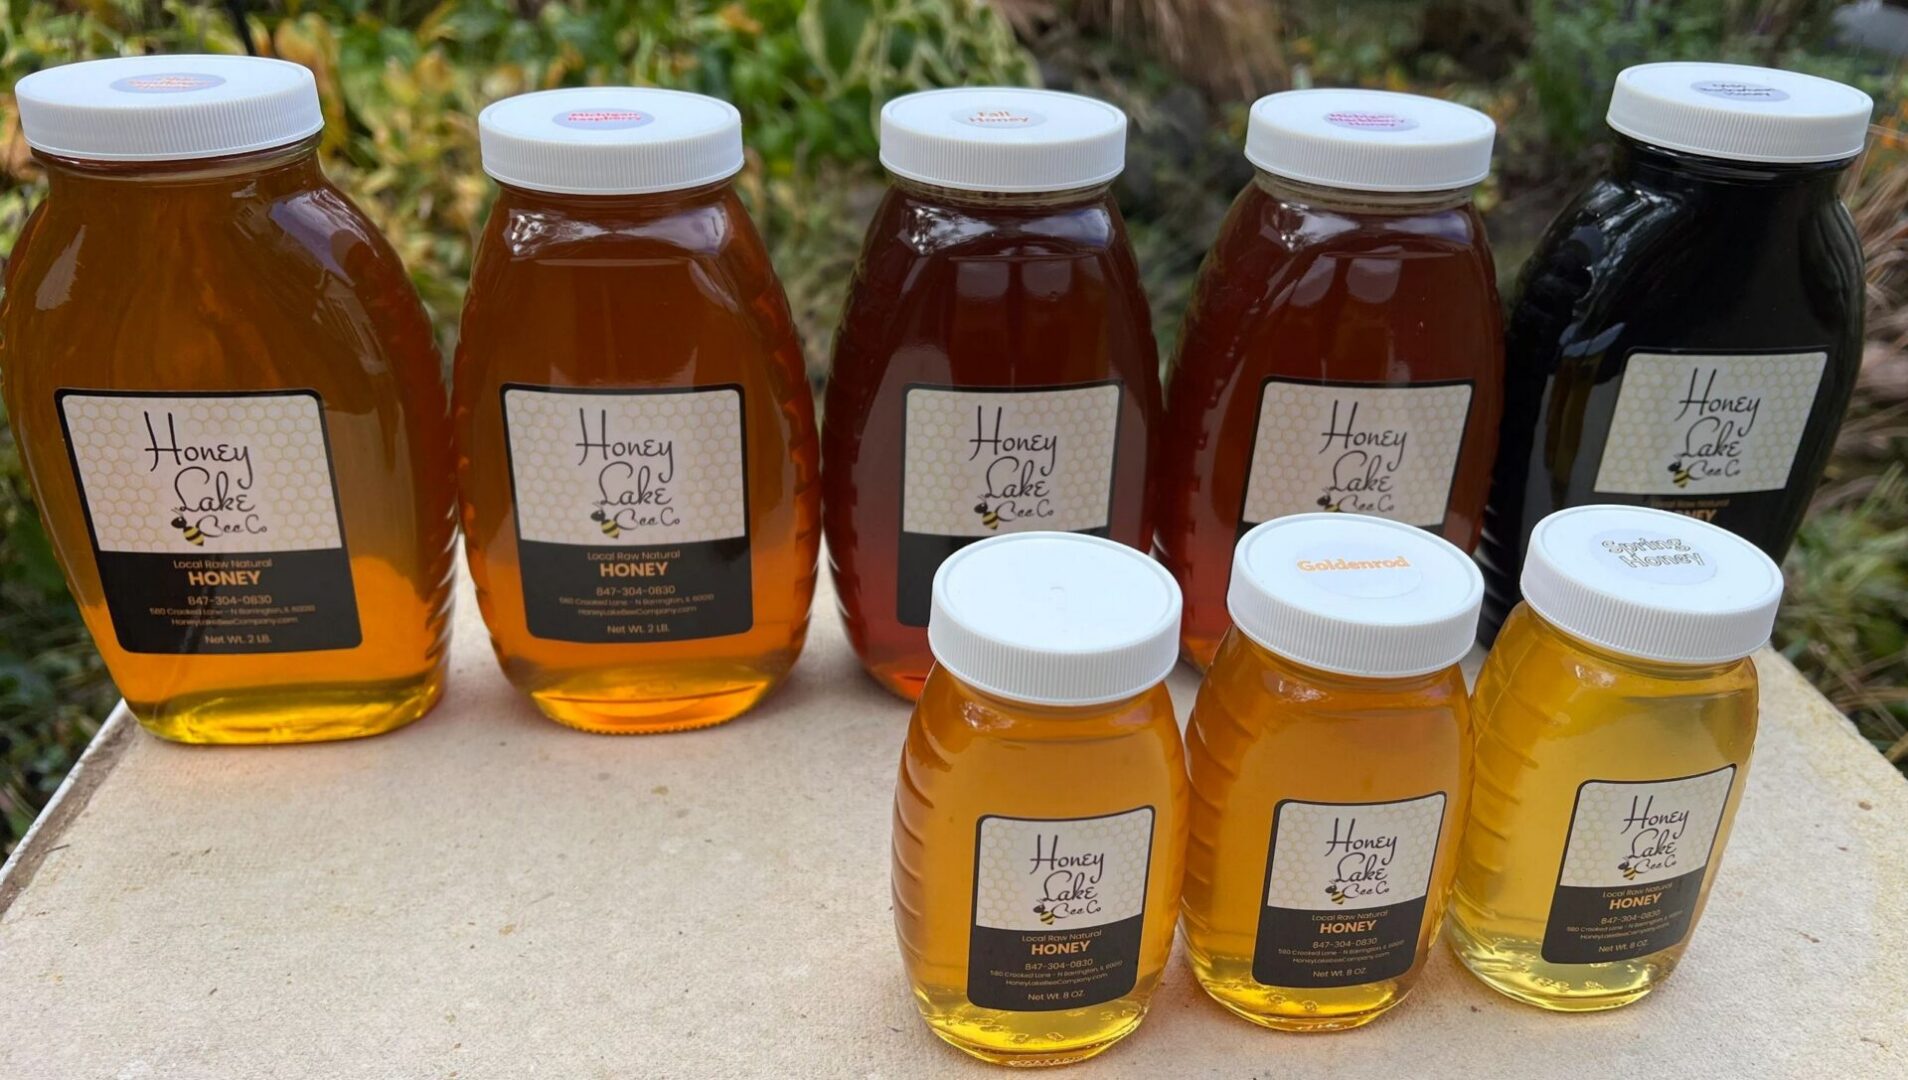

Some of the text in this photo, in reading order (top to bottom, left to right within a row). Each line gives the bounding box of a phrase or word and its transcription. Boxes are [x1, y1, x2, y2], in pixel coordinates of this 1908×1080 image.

[1675, 368, 1760, 437] Honey
[969, 405, 1057, 476] Honey
[1319, 400, 1408, 472] Honey
[1681, 416, 1742, 458] Lake
[144, 411, 254, 490] Honey
[575, 408, 674, 483] Honey
[1330, 450, 1393, 492] Lake
[1725, 460, 1741, 476] Co
[599, 461, 672, 505] Lake
[985, 456, 1049, 498] Lake
[174, 467, 255, 512] Lake
[1037, 499, 1054, 517] Co
[1378, 494, 1394, 512] Co
[246, 514, 267, 534] Co
[660, 507, 680, 526] Co
[587, 550, 680, 560] Local Raw Natural
[1601, 538, 1691, 555] Spring
[173, 558, 272, 569] Local Raw Natural
[1296, 556, 1411, 572] Goldenrod
[1619, 552, 1705, 568] Honey
[188, 570, 260, 586] HONEY
[600, 562, 668, 577] HONEY
[607, 625, 626, 634] Net
[648, 624, 654, 632] 2
[205, 635, 224, 644] Net
[247, 634, 254, 644] 2
[1620, 795, 1690, 840] Honey
[1324, 818, 1398, 866] Honey
[1628, 828, 1676, 859] Lake
[1030, 834, 1104, 884] Honey
[1335, 852, 1388, 882] Lake
[1664, 854, 1678, 868] Co
[1043, 870, 1098, 902] Lake
[1376, 880, 1390, 894] Co
[1602, 890, 1625, 898] Local
[1645, 882, 1672, 892] Natural
[1086, 900, 1101, 914] Co
[1610, 892, 1662, 910] HONEY
[1357, 910, 1388, 919] Natural
[1320, 920, 1376, 934] HONEY
[1048, 934, 1068, 942] Raw
[1070, 930, 1102, 940] Natural
[1312, 938, 1377, 948] 847-304-0830
[1031, 940, 1090, 956] HONEY
[1025, 958, 1094, 970] 847-304-0830
[1312, 970, 1328, 978] Net
